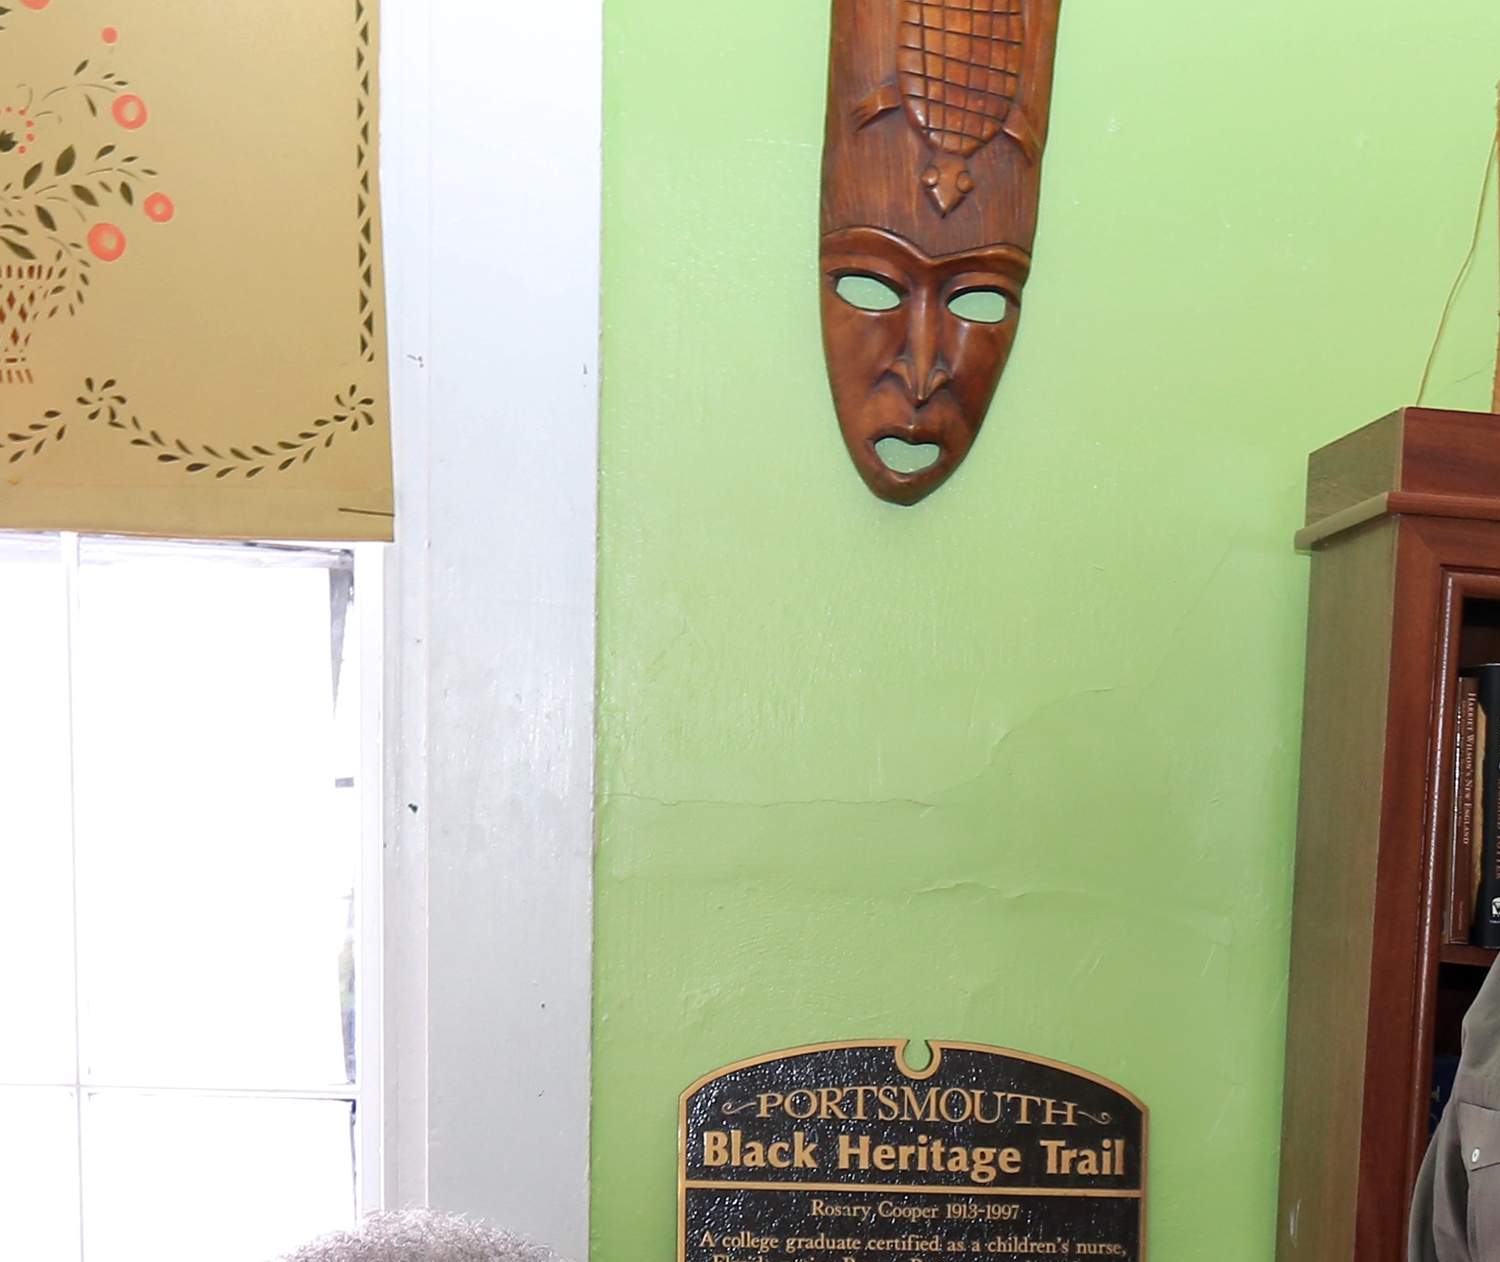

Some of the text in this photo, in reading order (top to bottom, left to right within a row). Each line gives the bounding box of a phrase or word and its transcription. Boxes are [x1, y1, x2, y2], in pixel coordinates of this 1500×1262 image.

[757, 1087, 1077, 1126] PORTSMOUTH
[704, 1129, 1124, 1180] Black Heritage Trail
[812, 1199, 1019, 1221] Rosary Cooper 1913-1997
[701, 1232, 1126, 1256] A college graduate certified as a children's nurse,
